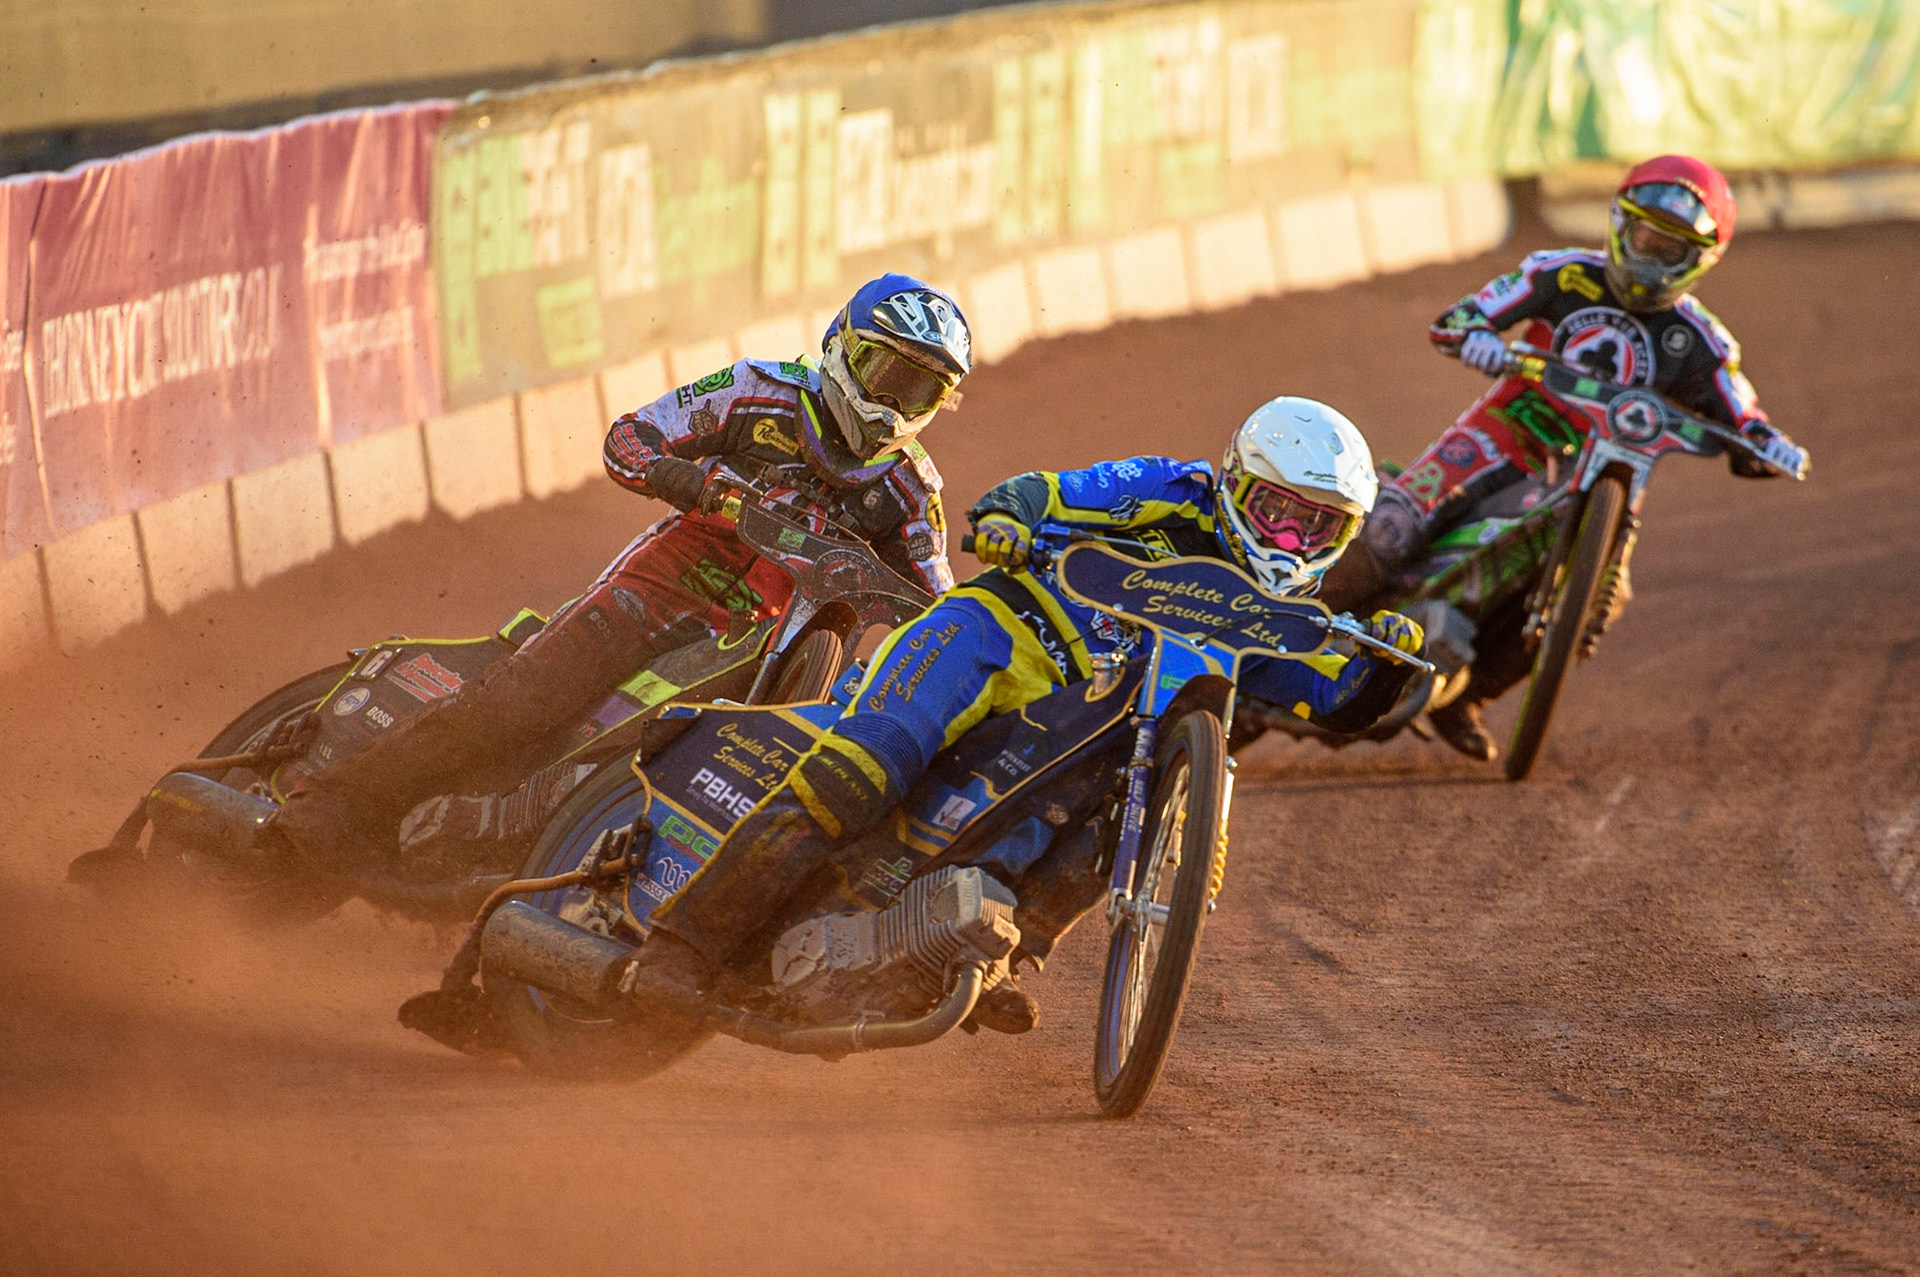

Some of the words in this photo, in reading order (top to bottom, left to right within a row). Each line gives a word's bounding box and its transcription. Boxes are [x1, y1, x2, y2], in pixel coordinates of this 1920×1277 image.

[1122, 569, 1224, 604] Complete
[909, 628, 934, 650] Car
[1240, 622, 1282, 647] Ltd
[361, 650, 393, 676] 6
[367, 706, 394, 728] BOSS
[717, 723, 765, 756] Complete
[762, 750, 788, 771] Car
[713, 746, 756, 777] Services
[690, 767, 757, 818] PBHS
